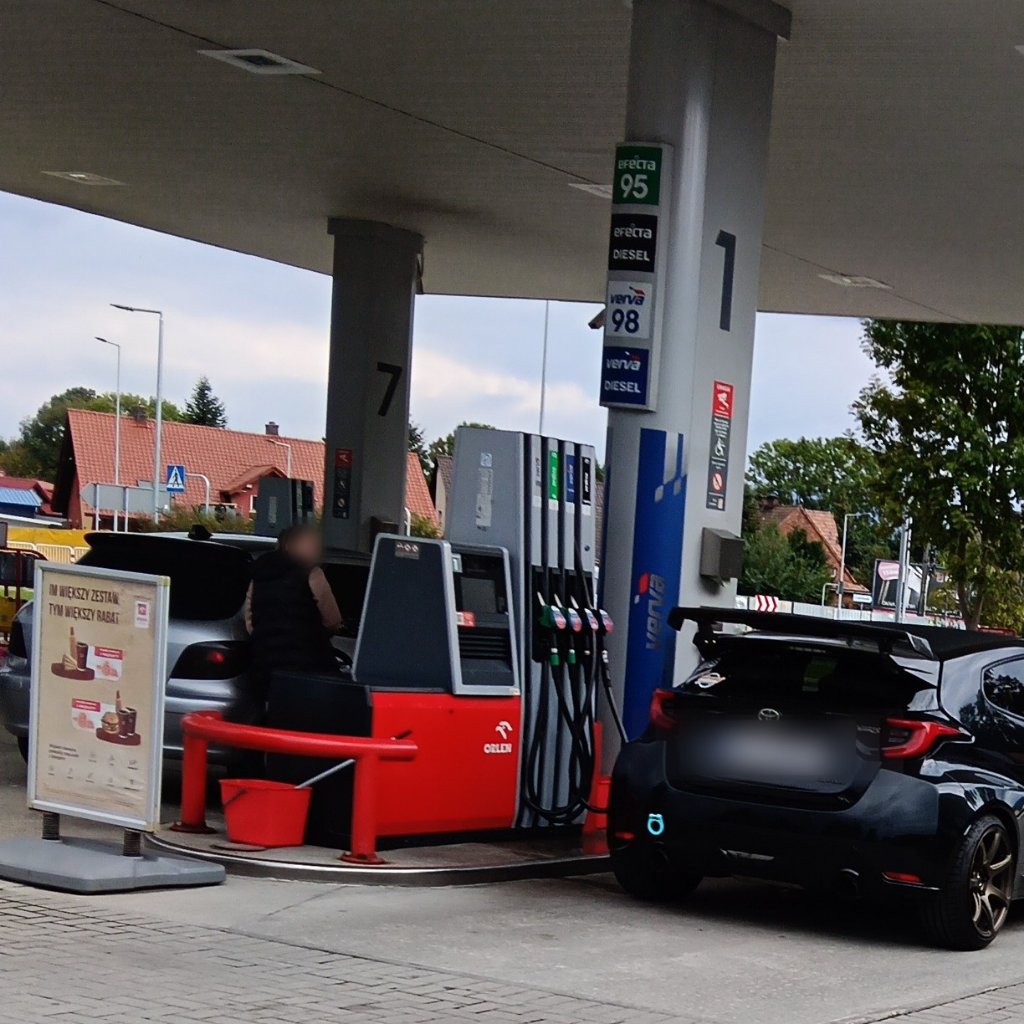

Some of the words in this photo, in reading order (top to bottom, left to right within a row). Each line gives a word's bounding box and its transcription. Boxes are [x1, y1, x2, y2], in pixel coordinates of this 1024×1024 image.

[621, 173, 649, 199] 95
[613, 249, 650, 262] DIESEL
[715, 229, 736, 332] 1
[610, 294, 645, 306] verva
[612, 308, 640, 334] 98
[606, 358, 641, 371] verva
[376, 361, 403, 417] 7
[604, 380, 641, 394] DIESEL
[49, 603, 63, 616] TYM
[645, 573, 666, 650] verva
[483, 743, 513, 754] ORLEN
